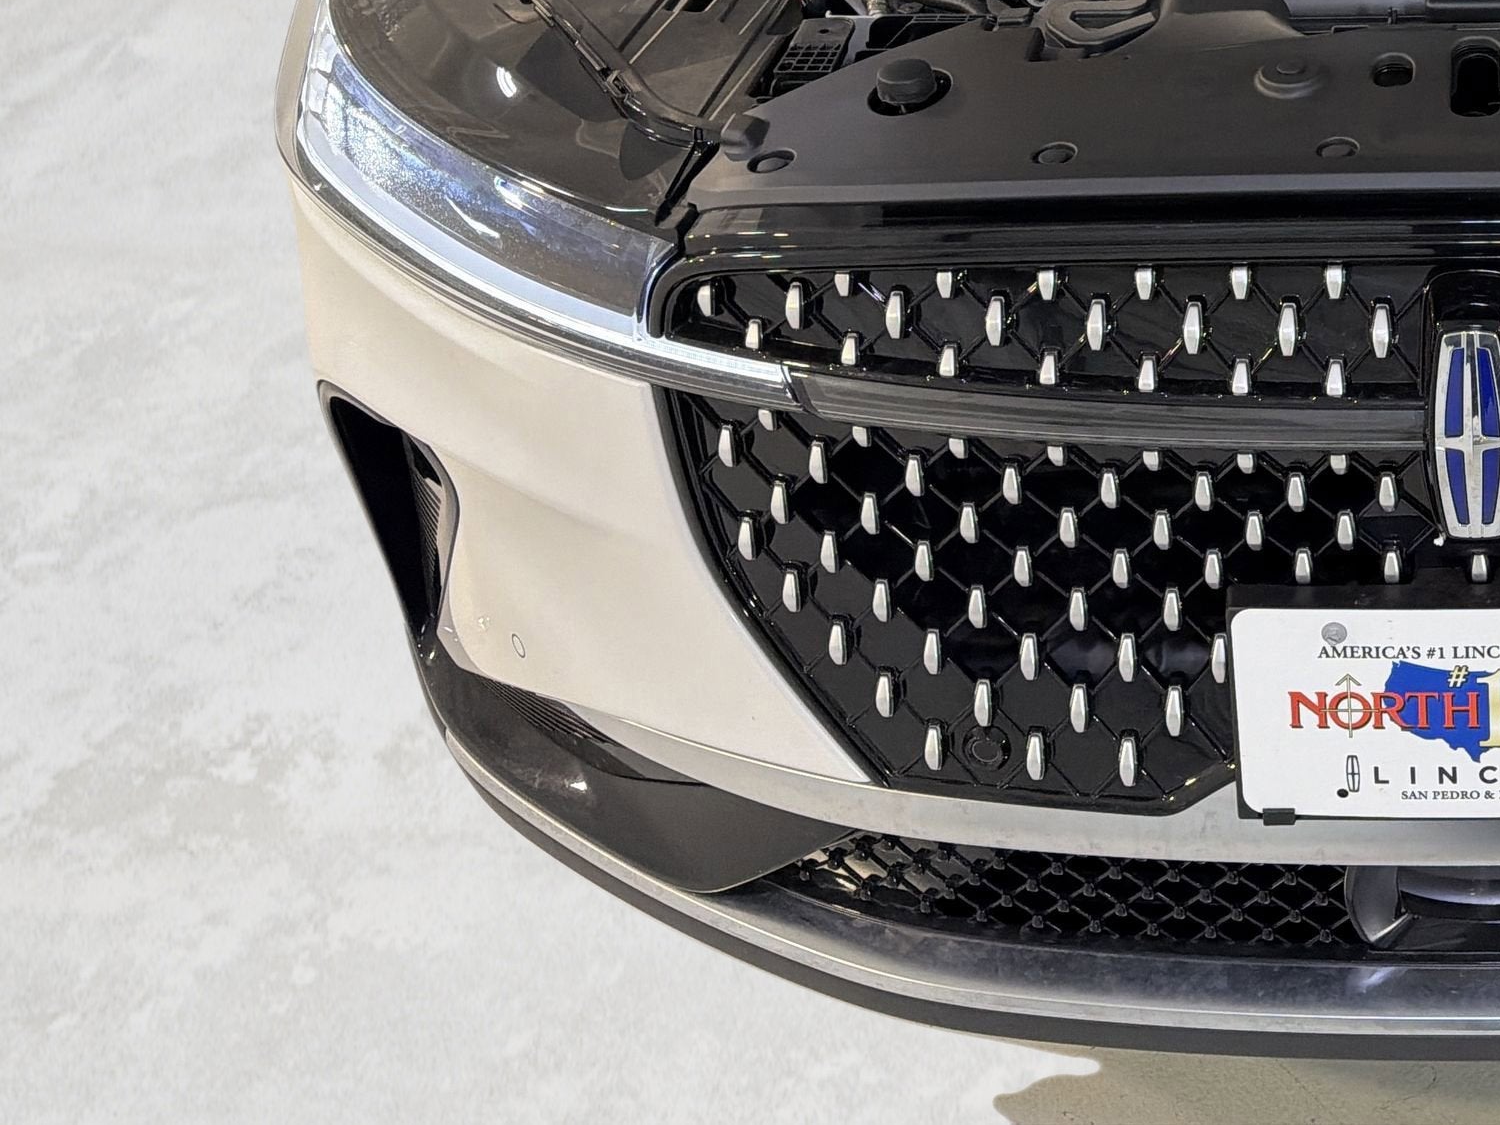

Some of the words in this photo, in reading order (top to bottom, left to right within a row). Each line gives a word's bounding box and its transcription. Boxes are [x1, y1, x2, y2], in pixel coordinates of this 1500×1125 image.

[1318, 645, 1421, 660] AMERICA'S
[1426, 646, 1446, 659] #1
[1401, 790, 1428, 800] SAN
[1432, 790, 1481, 800] PEDRO
[1484, 790, 1495, 800] &
